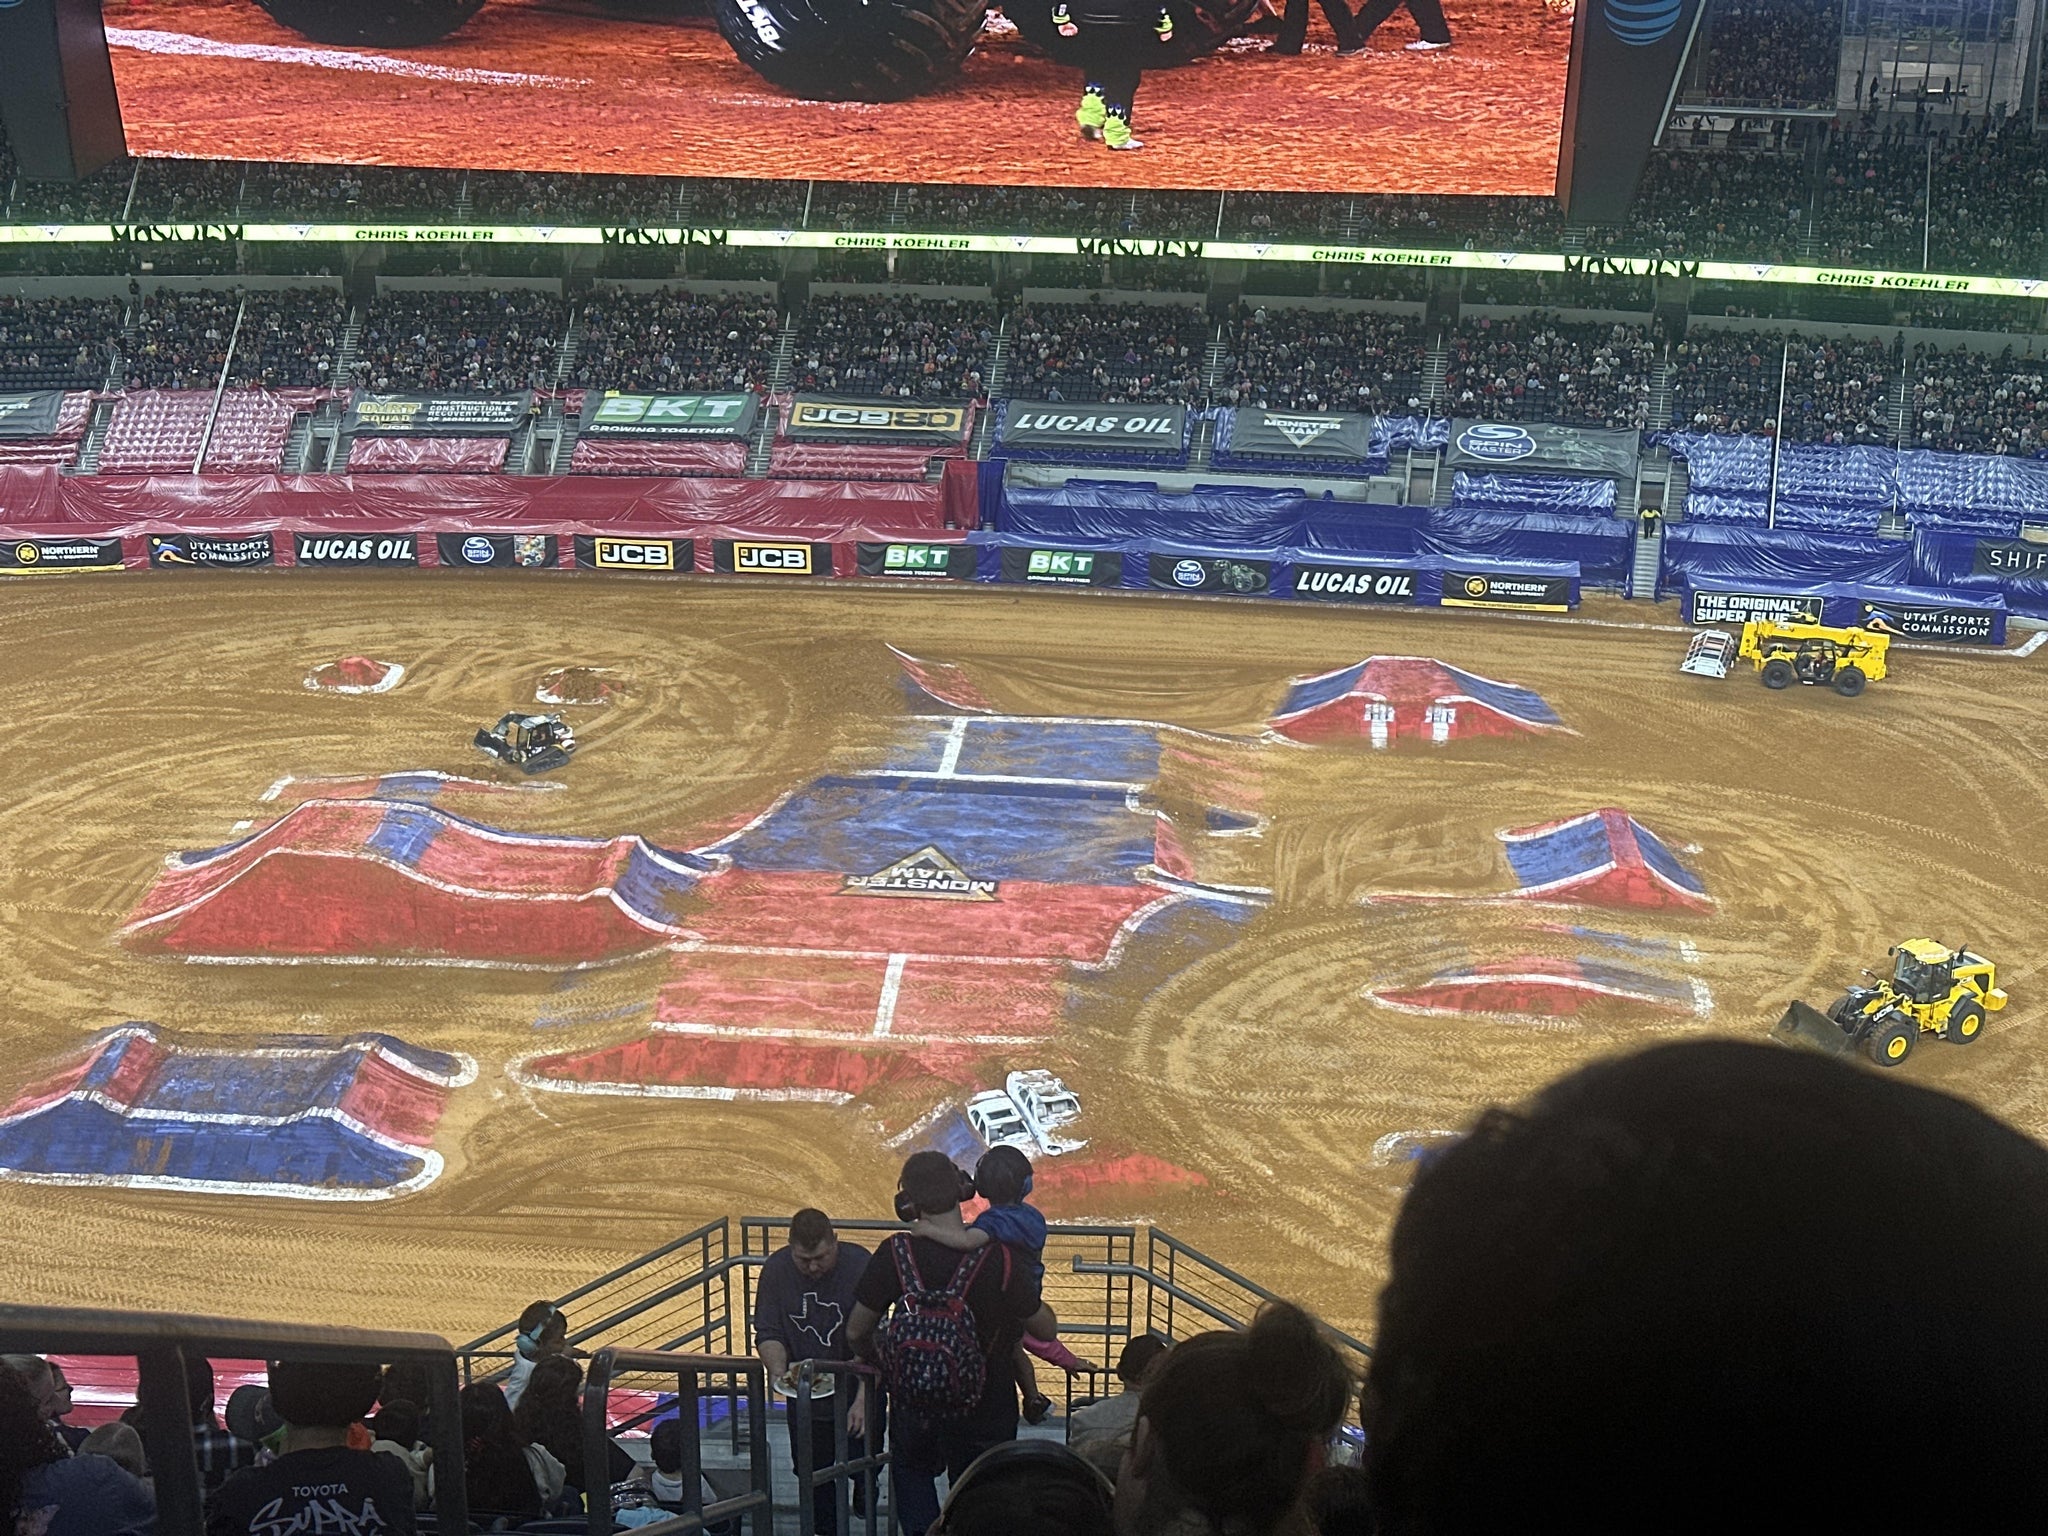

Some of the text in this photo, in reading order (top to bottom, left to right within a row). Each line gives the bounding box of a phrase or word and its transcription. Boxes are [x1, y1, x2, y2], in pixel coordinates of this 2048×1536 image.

[355, 230, 494, 240] CHRIS KOEHLER
[835, 237, 970, 249] CHRIS KOEHLER
[1312, 250, 1452, 265] CHRIS KOEHLER
[1816, 273, 1970, 290] CHRIS KOEHLER
[601, 399, 742, 417] BKT
[361, 415, 411, 426] SQUAD
[802, 408, 890, 425] JCB
[1014, 414, 1118, 432] LUCAS
[590, 425, 657, 433] GROWING
[1263, 419, 1341, 430] MONSTER
[1468, 445, 1522, 454] MASTER
[1469, 439, 1523, 448] SPIN
[41, 546, 99, 555] NORTHERN
[189, 541, 269, 551] UTAH SPORTS
[300, 540, 373, 560] LUCAS
[191, 551, 270, 560] COMMISSION
[602, 544, 667, 563] JCB
[740, 549, 805, 568] JCB
[886, 549, 947, 564] BKT
[1990, 550, 2046, 569] SHIF
[1030, 554, 1092, 571] BKT
[1297, 572, 1372, 594] LUCAS
[1490, 581, 1547, 592] NORTHERN
[1698, 595, 1799, 612] THE ORIGINAL
[1697, 608, 1746, 622] SUPER
[1903, 612, 1990, 626] UTAH SPORTS
[1902, 623, 1989, 636] COMMISSION
[891, 867, 955, 879] JAM
[847, 876, 995, 891] MONSTER
[1873, 1004, 1894, 1021] JCB
[292, 1484, 348, 1497] TOYOTA
[249, 1497, 387, 1536] SUPRA
